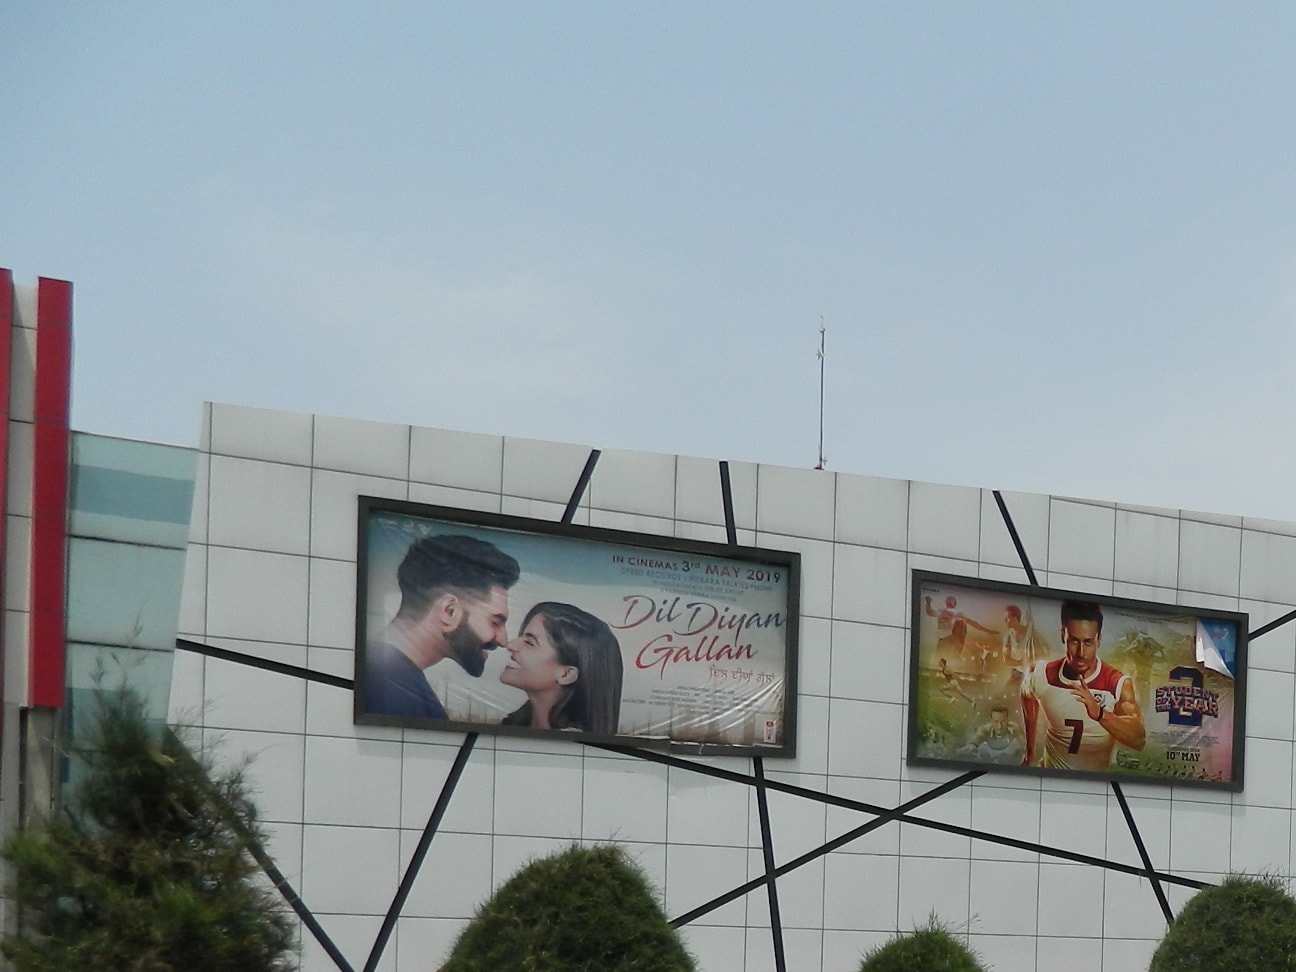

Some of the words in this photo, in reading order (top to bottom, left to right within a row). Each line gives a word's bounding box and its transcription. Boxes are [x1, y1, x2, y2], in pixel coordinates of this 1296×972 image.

[612, 555, 624, 564] IN
[628, 556, 678, 571] CINEMAS
[705, 564, 742, 578] MAY
[747, 569, 781, 584] 2019
[609, 594, 682, 629] Dil
[672, 602, 786, 647] Diyan
[635, 634, 759, 680] Gallan
[1156, 686, 1219, 700] STUDENT
[1171, 697, 1219, 717] YEAR
[1064, 718, 1084, 754] 7
[1181, 752, 1200, 761] MAY
